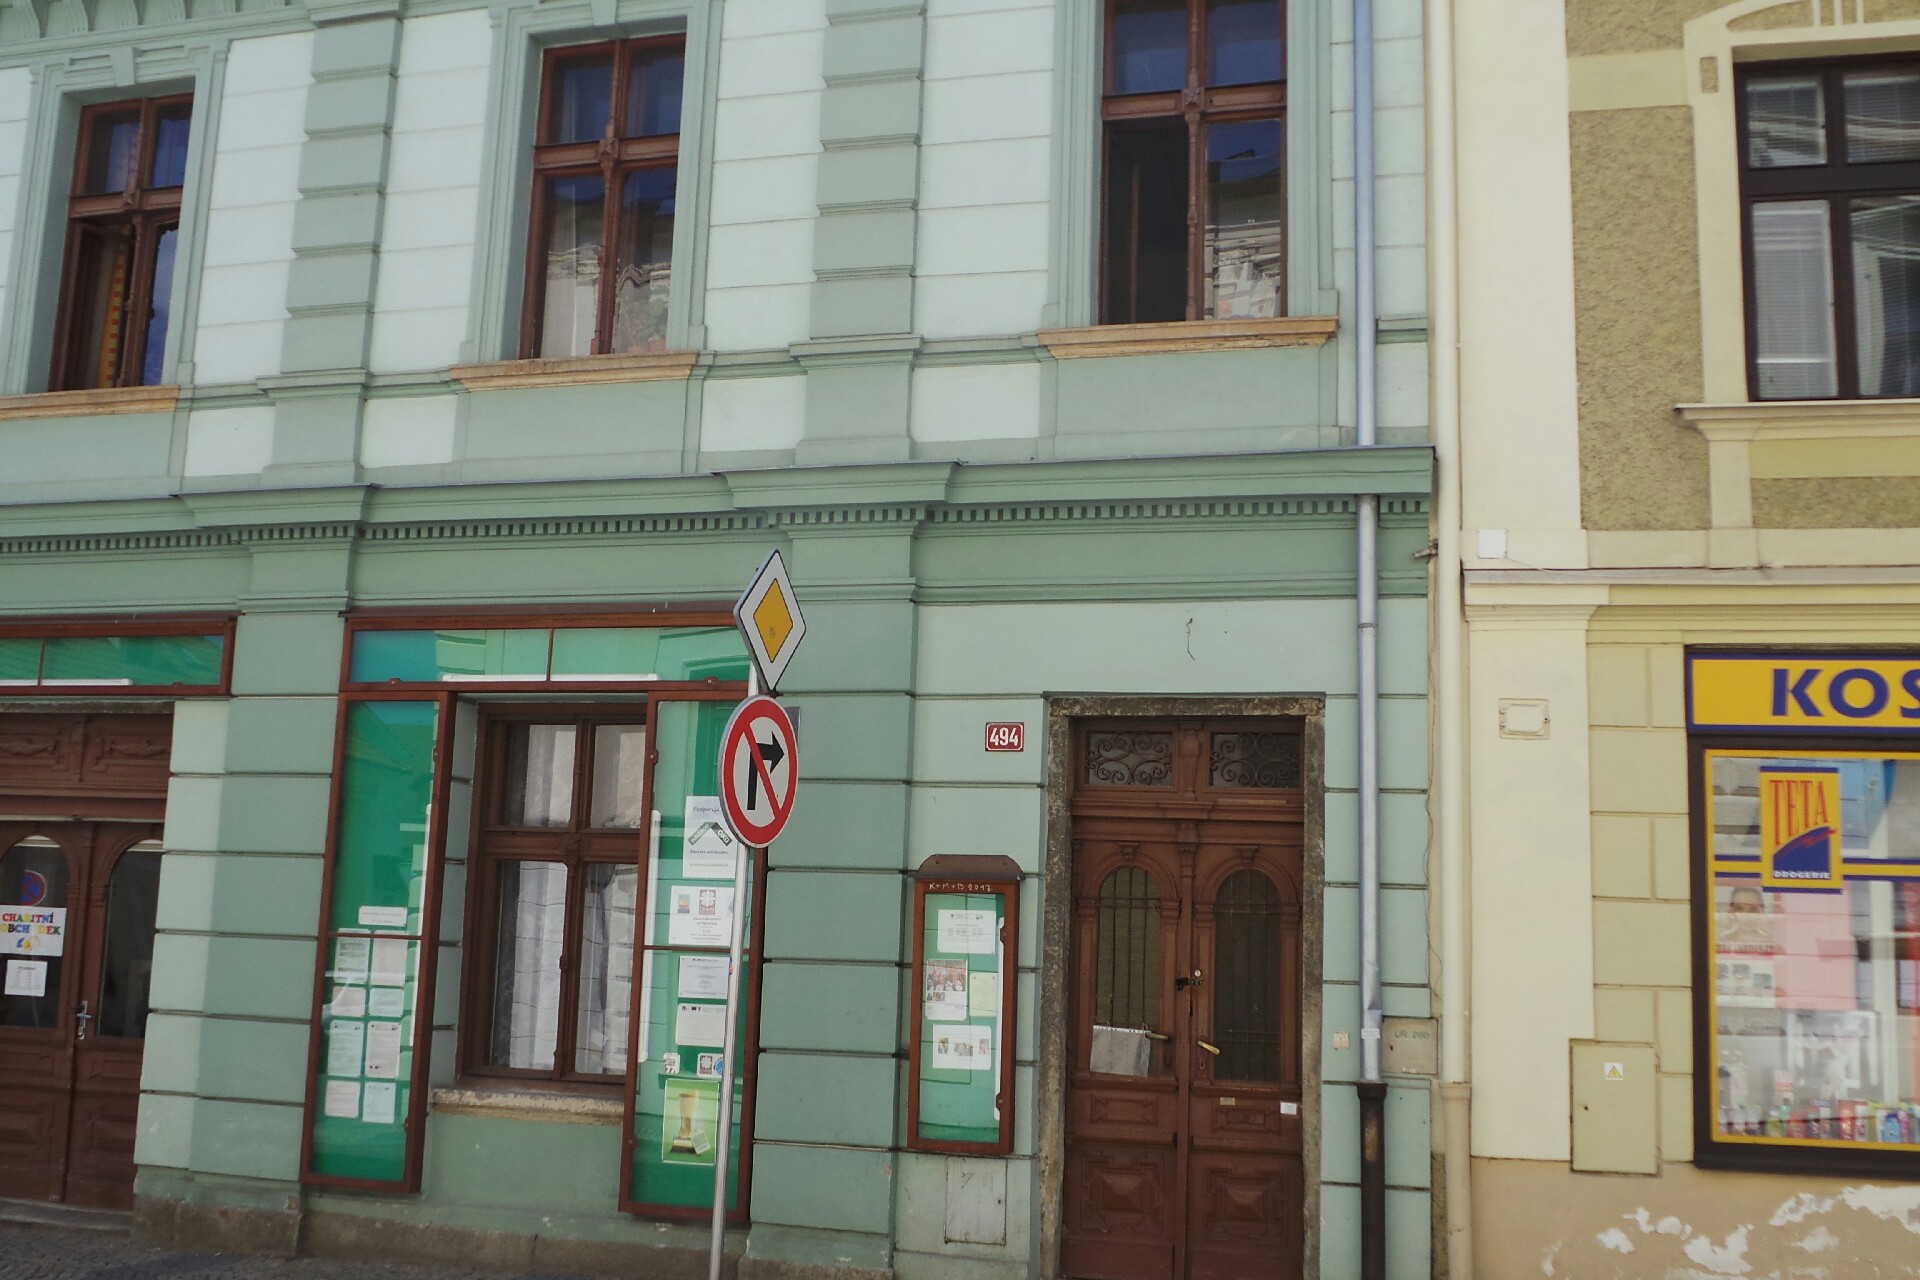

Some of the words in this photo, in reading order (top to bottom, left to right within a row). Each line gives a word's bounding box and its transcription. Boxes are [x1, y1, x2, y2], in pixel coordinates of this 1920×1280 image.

[990, 727, 1018, 746] 494
[1770, 780, 1829, 849] TETA
[1774, 870, 1831, 879] DROGERIE
[0, 923, 61, 935] OBCHDEK
